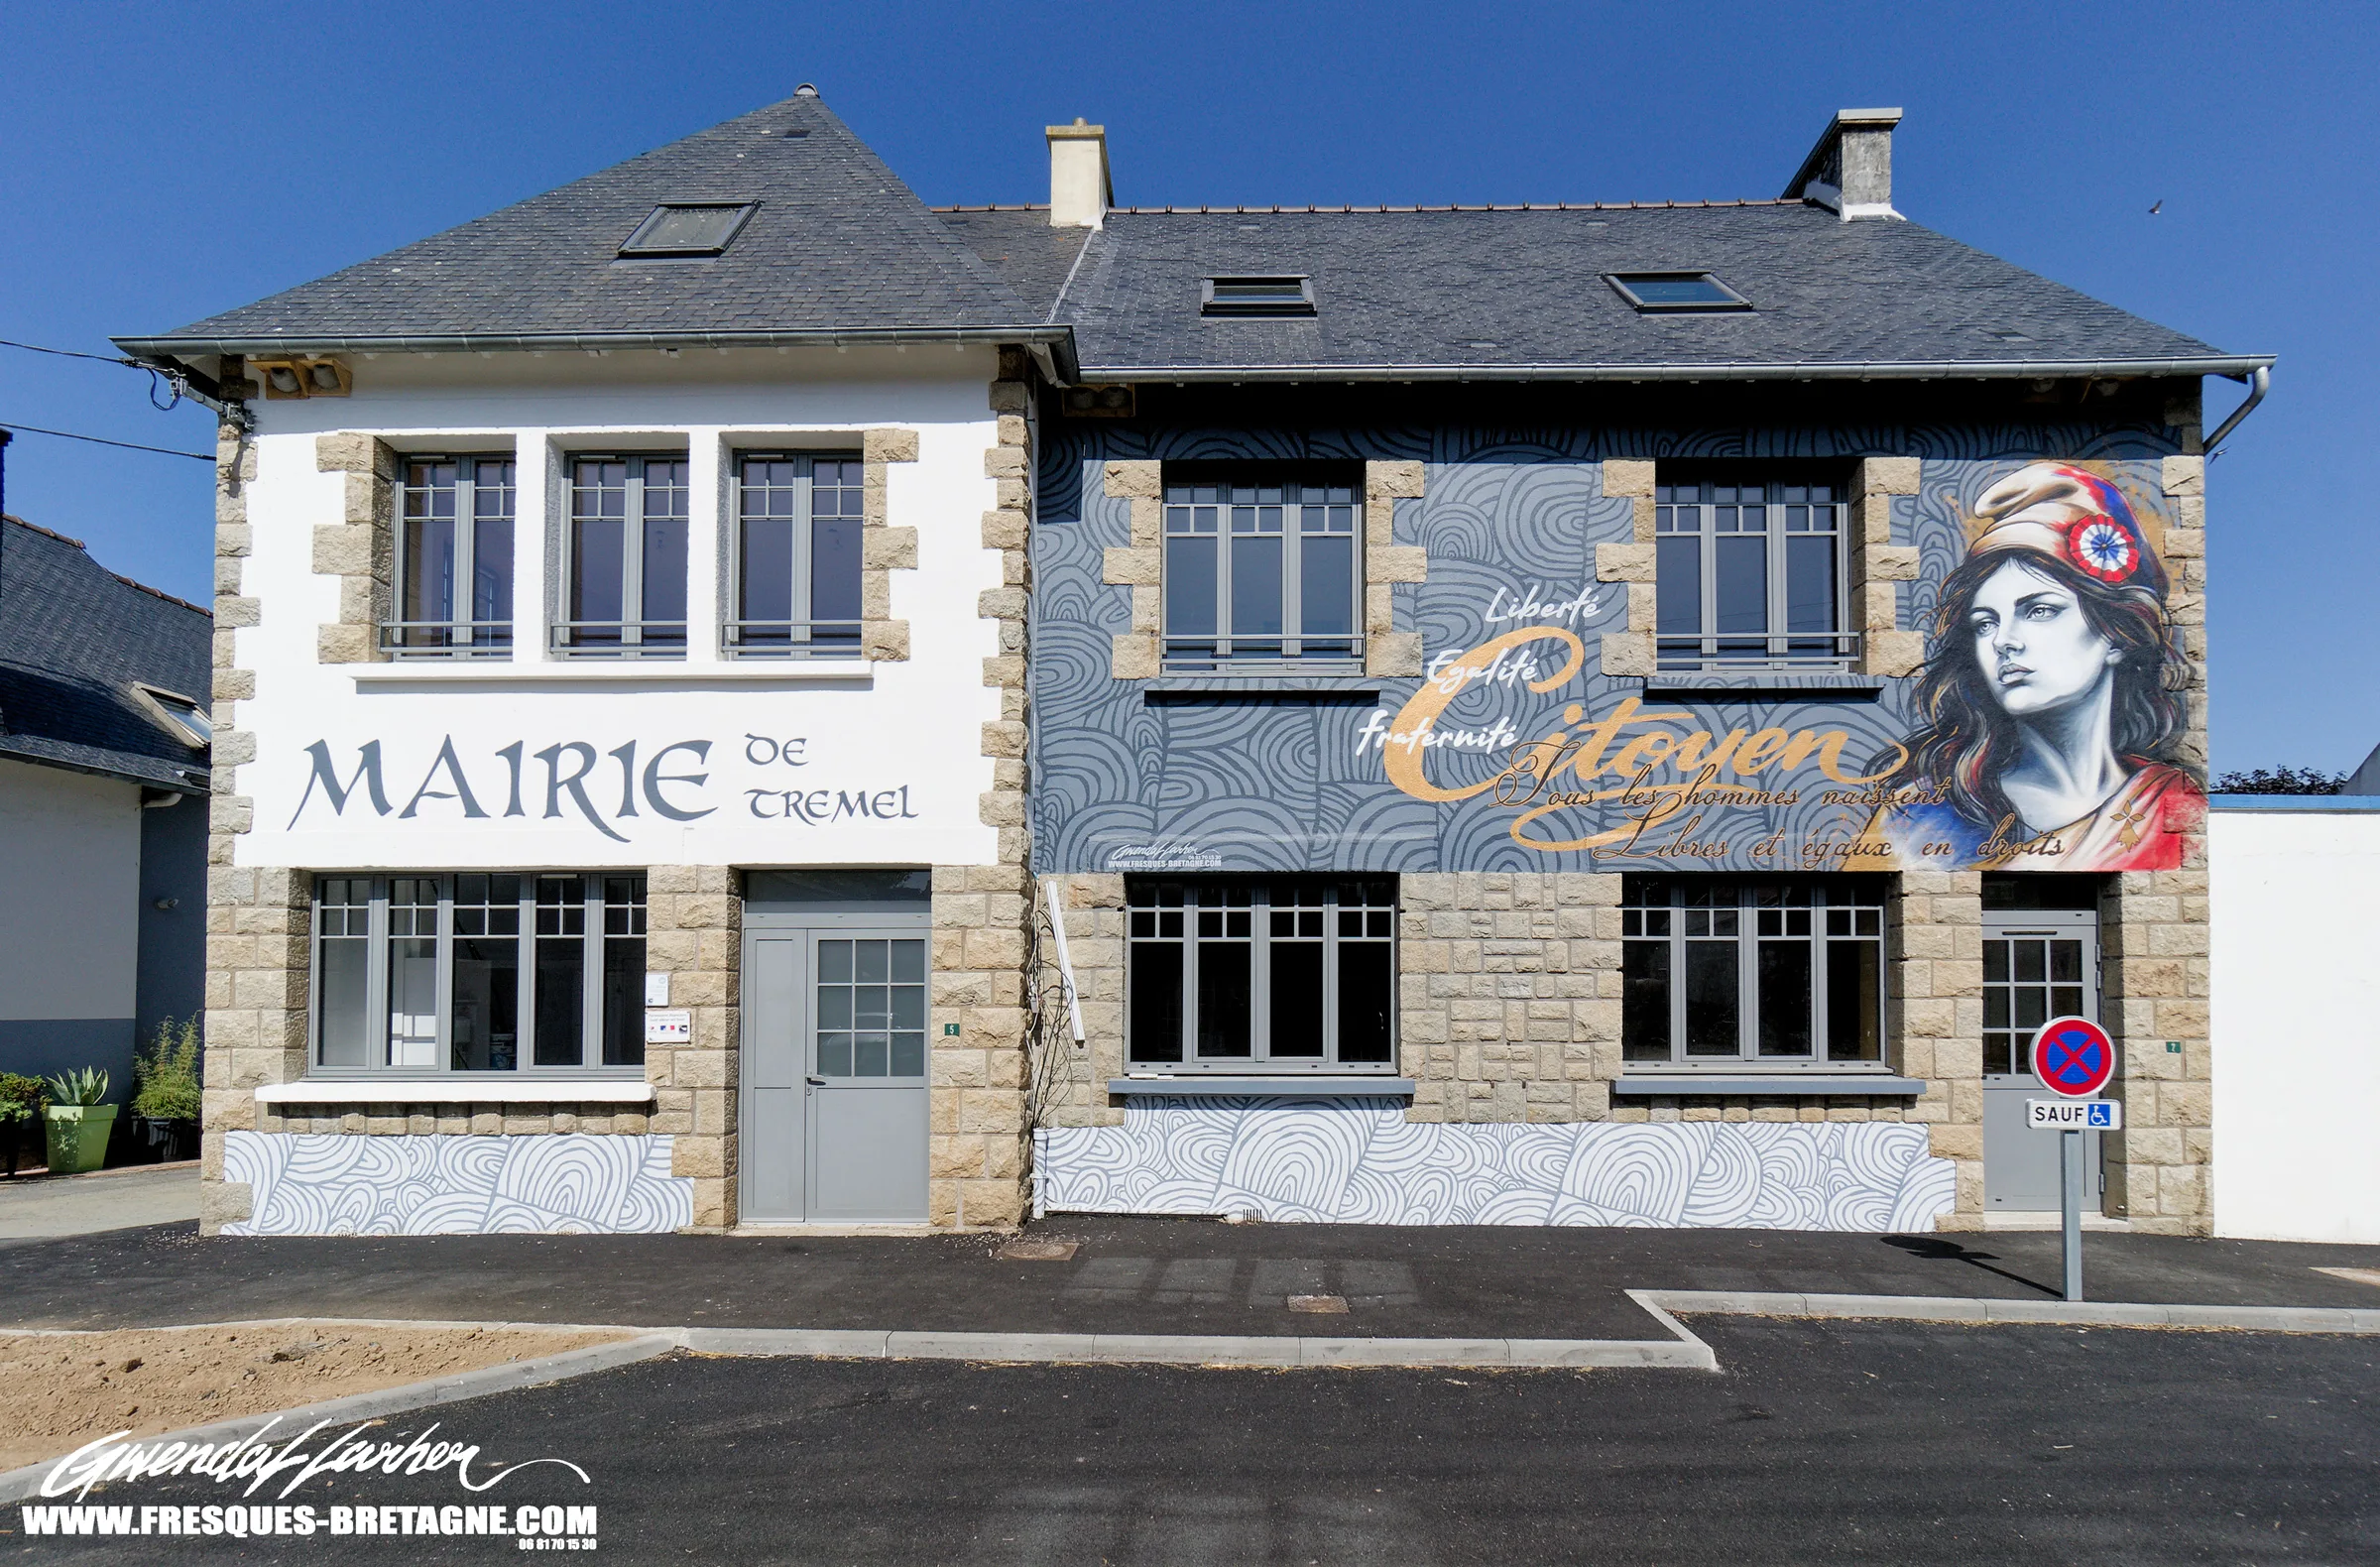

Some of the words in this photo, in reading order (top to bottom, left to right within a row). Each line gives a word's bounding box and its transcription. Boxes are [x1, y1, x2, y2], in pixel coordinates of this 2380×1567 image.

[1485, 584, 1603, 625] Liberté
[1426, 648, 1538, 694] Egalité
[745, 732, 809, 767] DE
[1384, 625, 1909, 851] Citoyen
[287, 733, 719, 843] MAIRIE
[1488, 740, 1597, 807] Tous
[1619, 763, 1658, 806] les
[1682, 763, 1799, 806] hommes
[1822, 777, 1952, 806] naissent
[744, 784, 920, 825] TREMEL
[1592, 791, 1730, 860] Libres
[1752, 827, 1786, 858] et
[1801, 828, 1893, 869] égaux
[1921, 840, 1956, 857] en
[1976, 812, 2067, 858] droits
[950, 1025, 955, 1034] 5
[2034, 1106, 2084, 1122] SAUF
